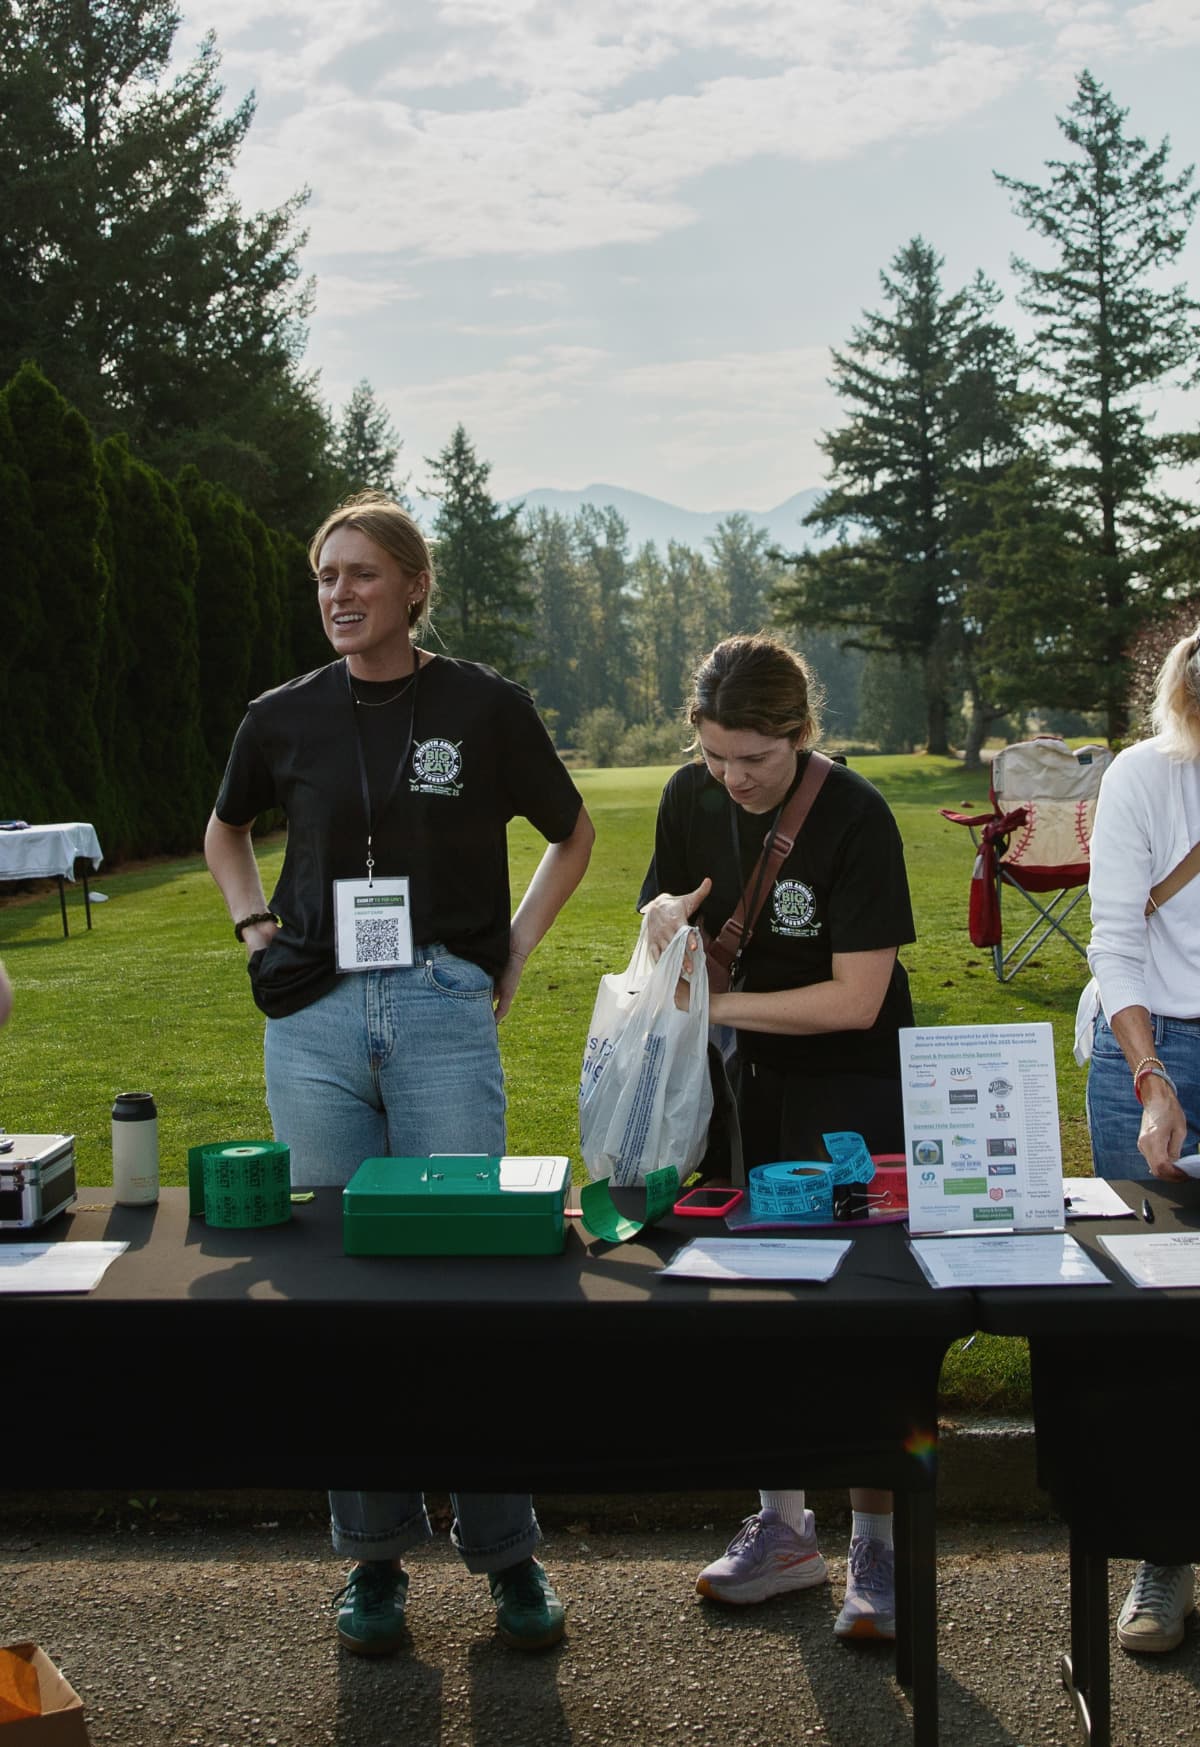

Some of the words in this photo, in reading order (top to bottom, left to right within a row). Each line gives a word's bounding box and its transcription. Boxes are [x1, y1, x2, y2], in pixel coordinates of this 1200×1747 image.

[425, 750, 450, 761] BIG
[782, 891, 805, 903] BIG
[950, 1066, 972, 1076] aws
